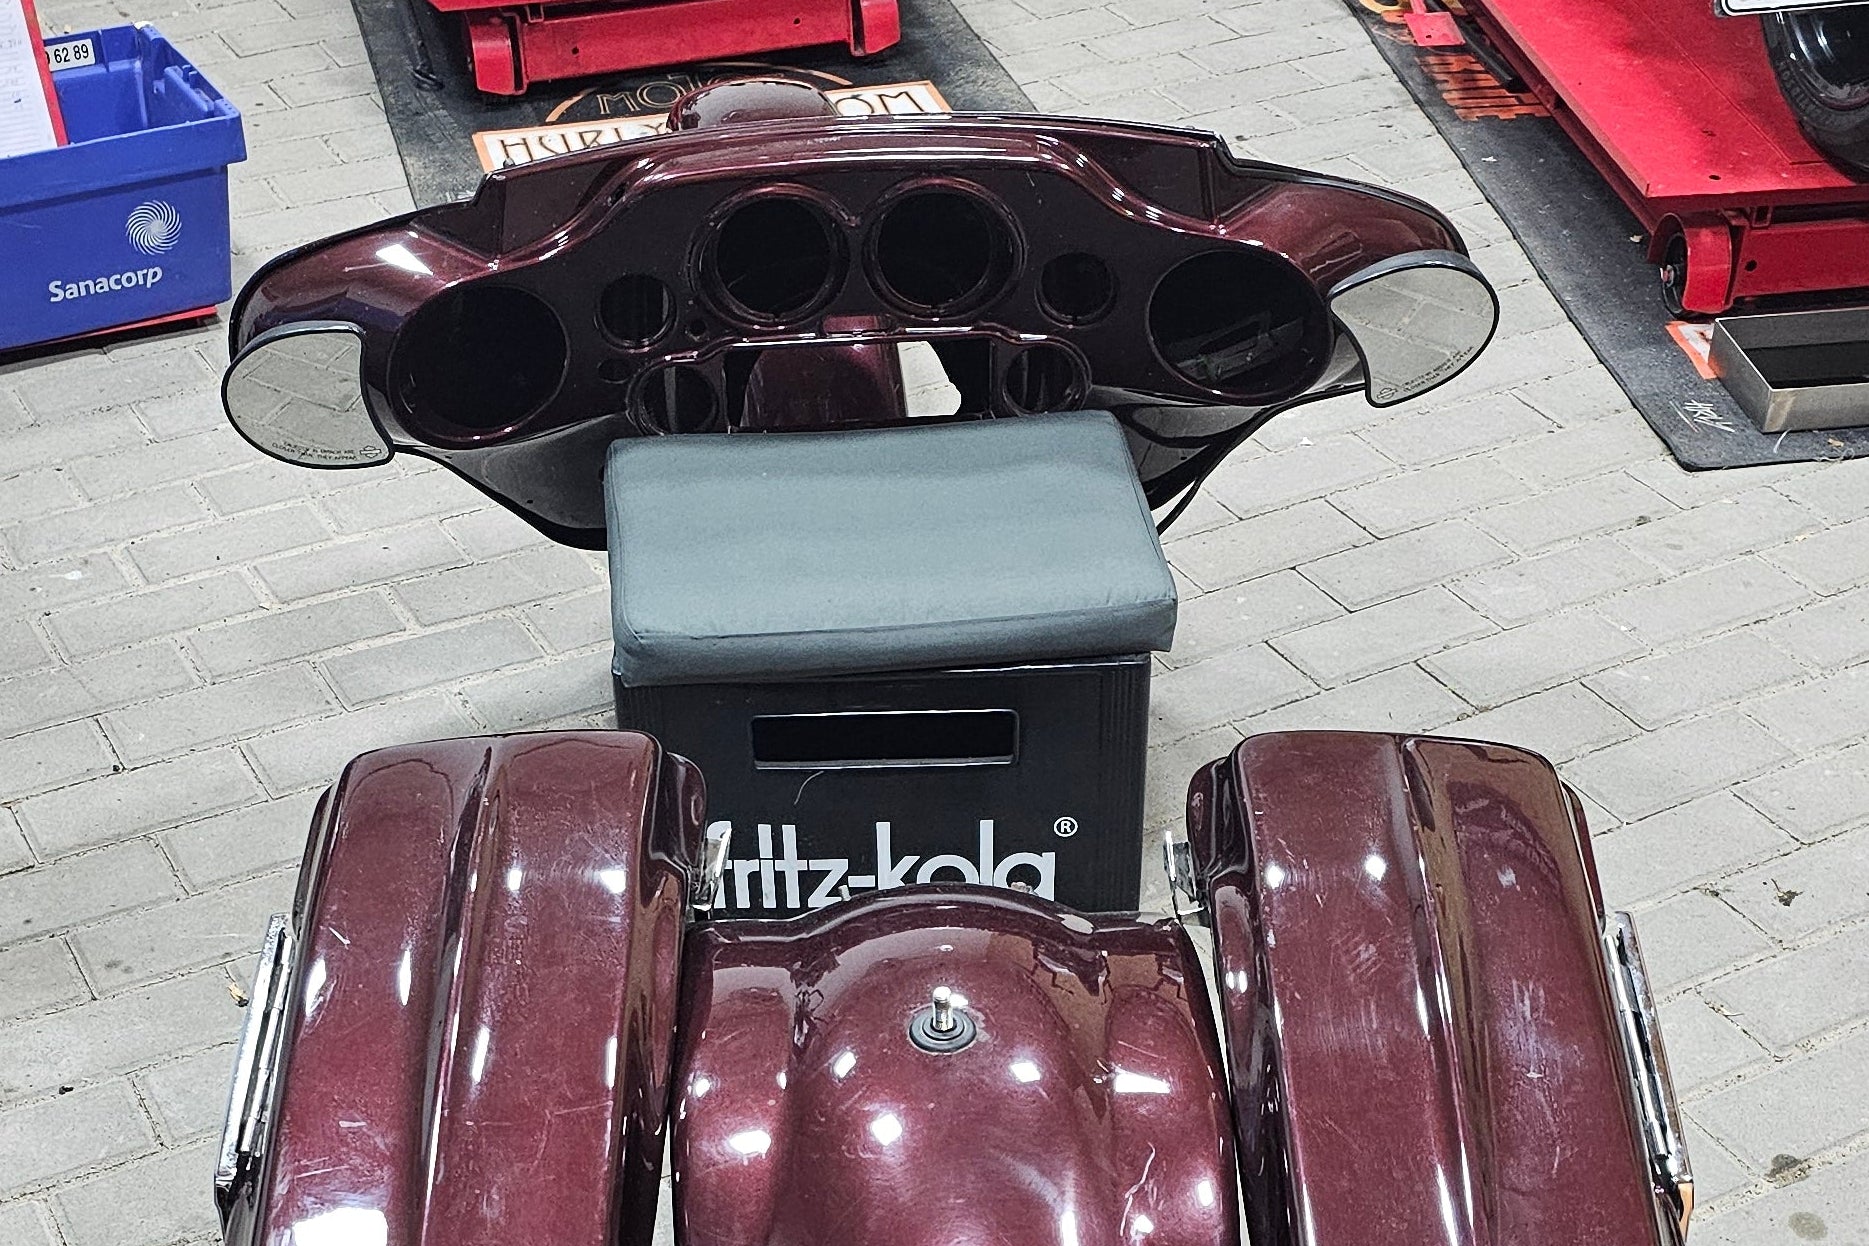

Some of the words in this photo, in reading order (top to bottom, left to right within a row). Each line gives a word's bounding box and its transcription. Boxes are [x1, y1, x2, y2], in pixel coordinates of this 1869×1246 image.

[54, 48, 70, 63] 62
[73, 43, 89, 59] 89
[49, 265, 162, 302] Sanacorp
[704, 819, 1056, 909] fritz-kola
